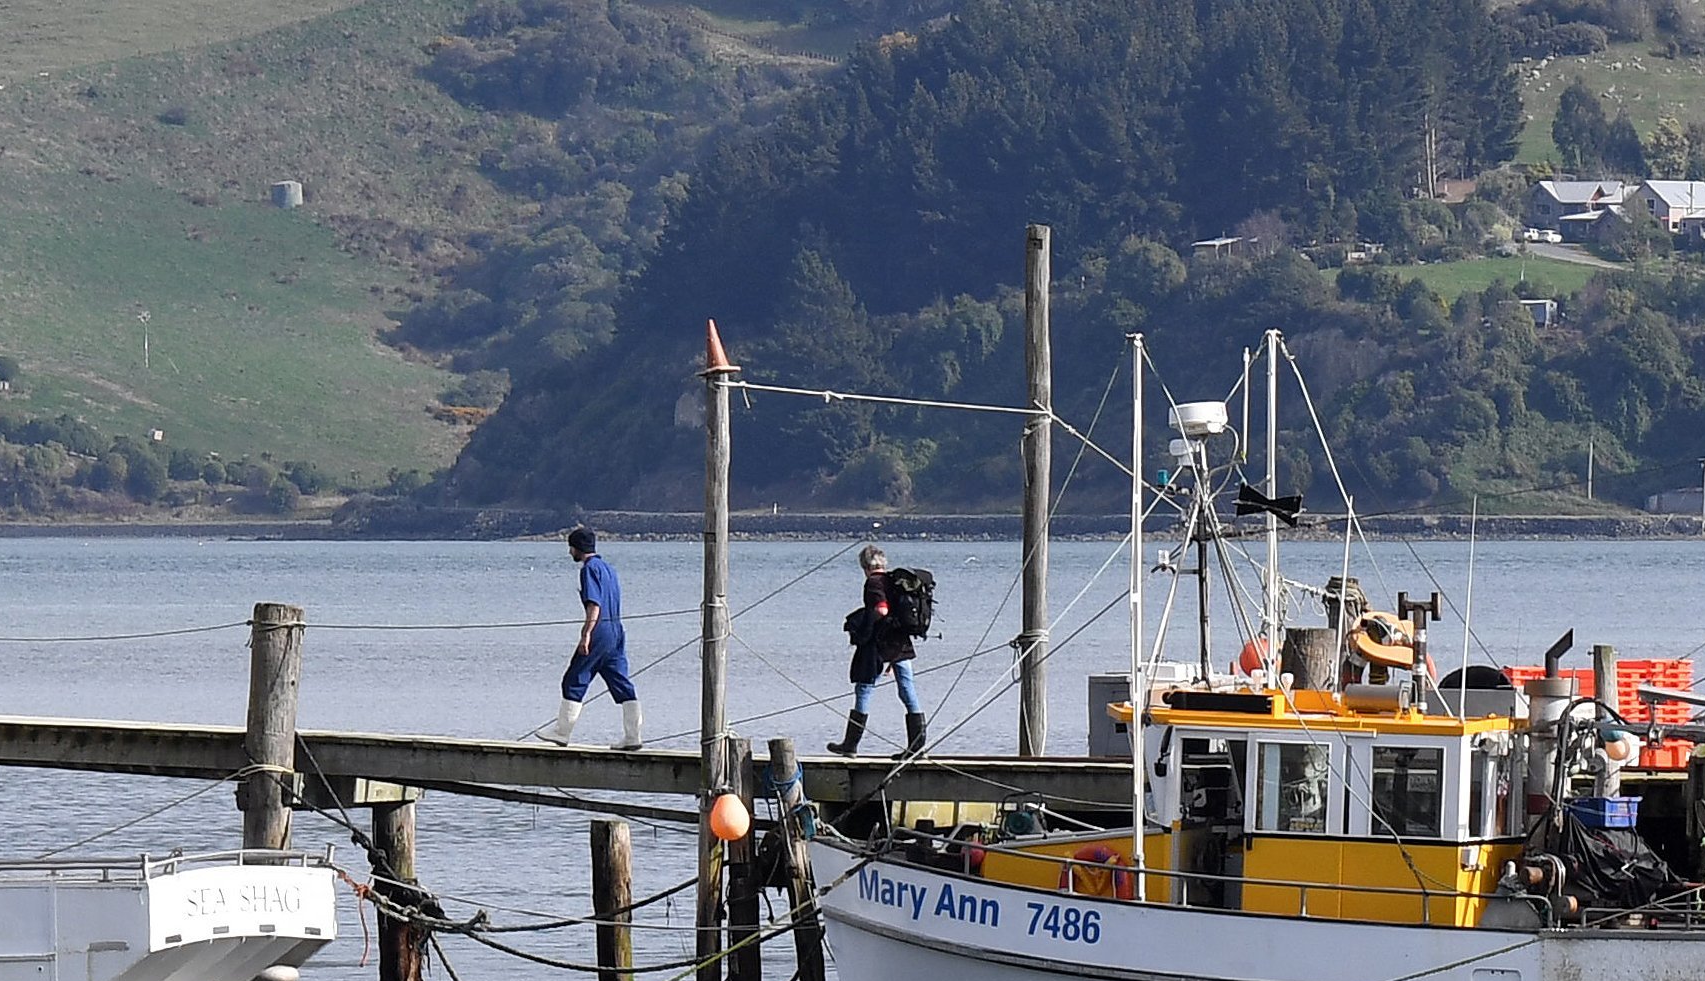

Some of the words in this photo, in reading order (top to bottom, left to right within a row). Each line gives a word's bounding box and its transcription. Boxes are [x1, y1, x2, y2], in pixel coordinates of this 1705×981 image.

[187, 888, 228, 916] SEA
[240, 885, 300, 913] SHAG
[858, 867, 927, 920] Mary
[934, 883, 1000, 927] Ann
[1026, 902, 1101, 944] 7486
